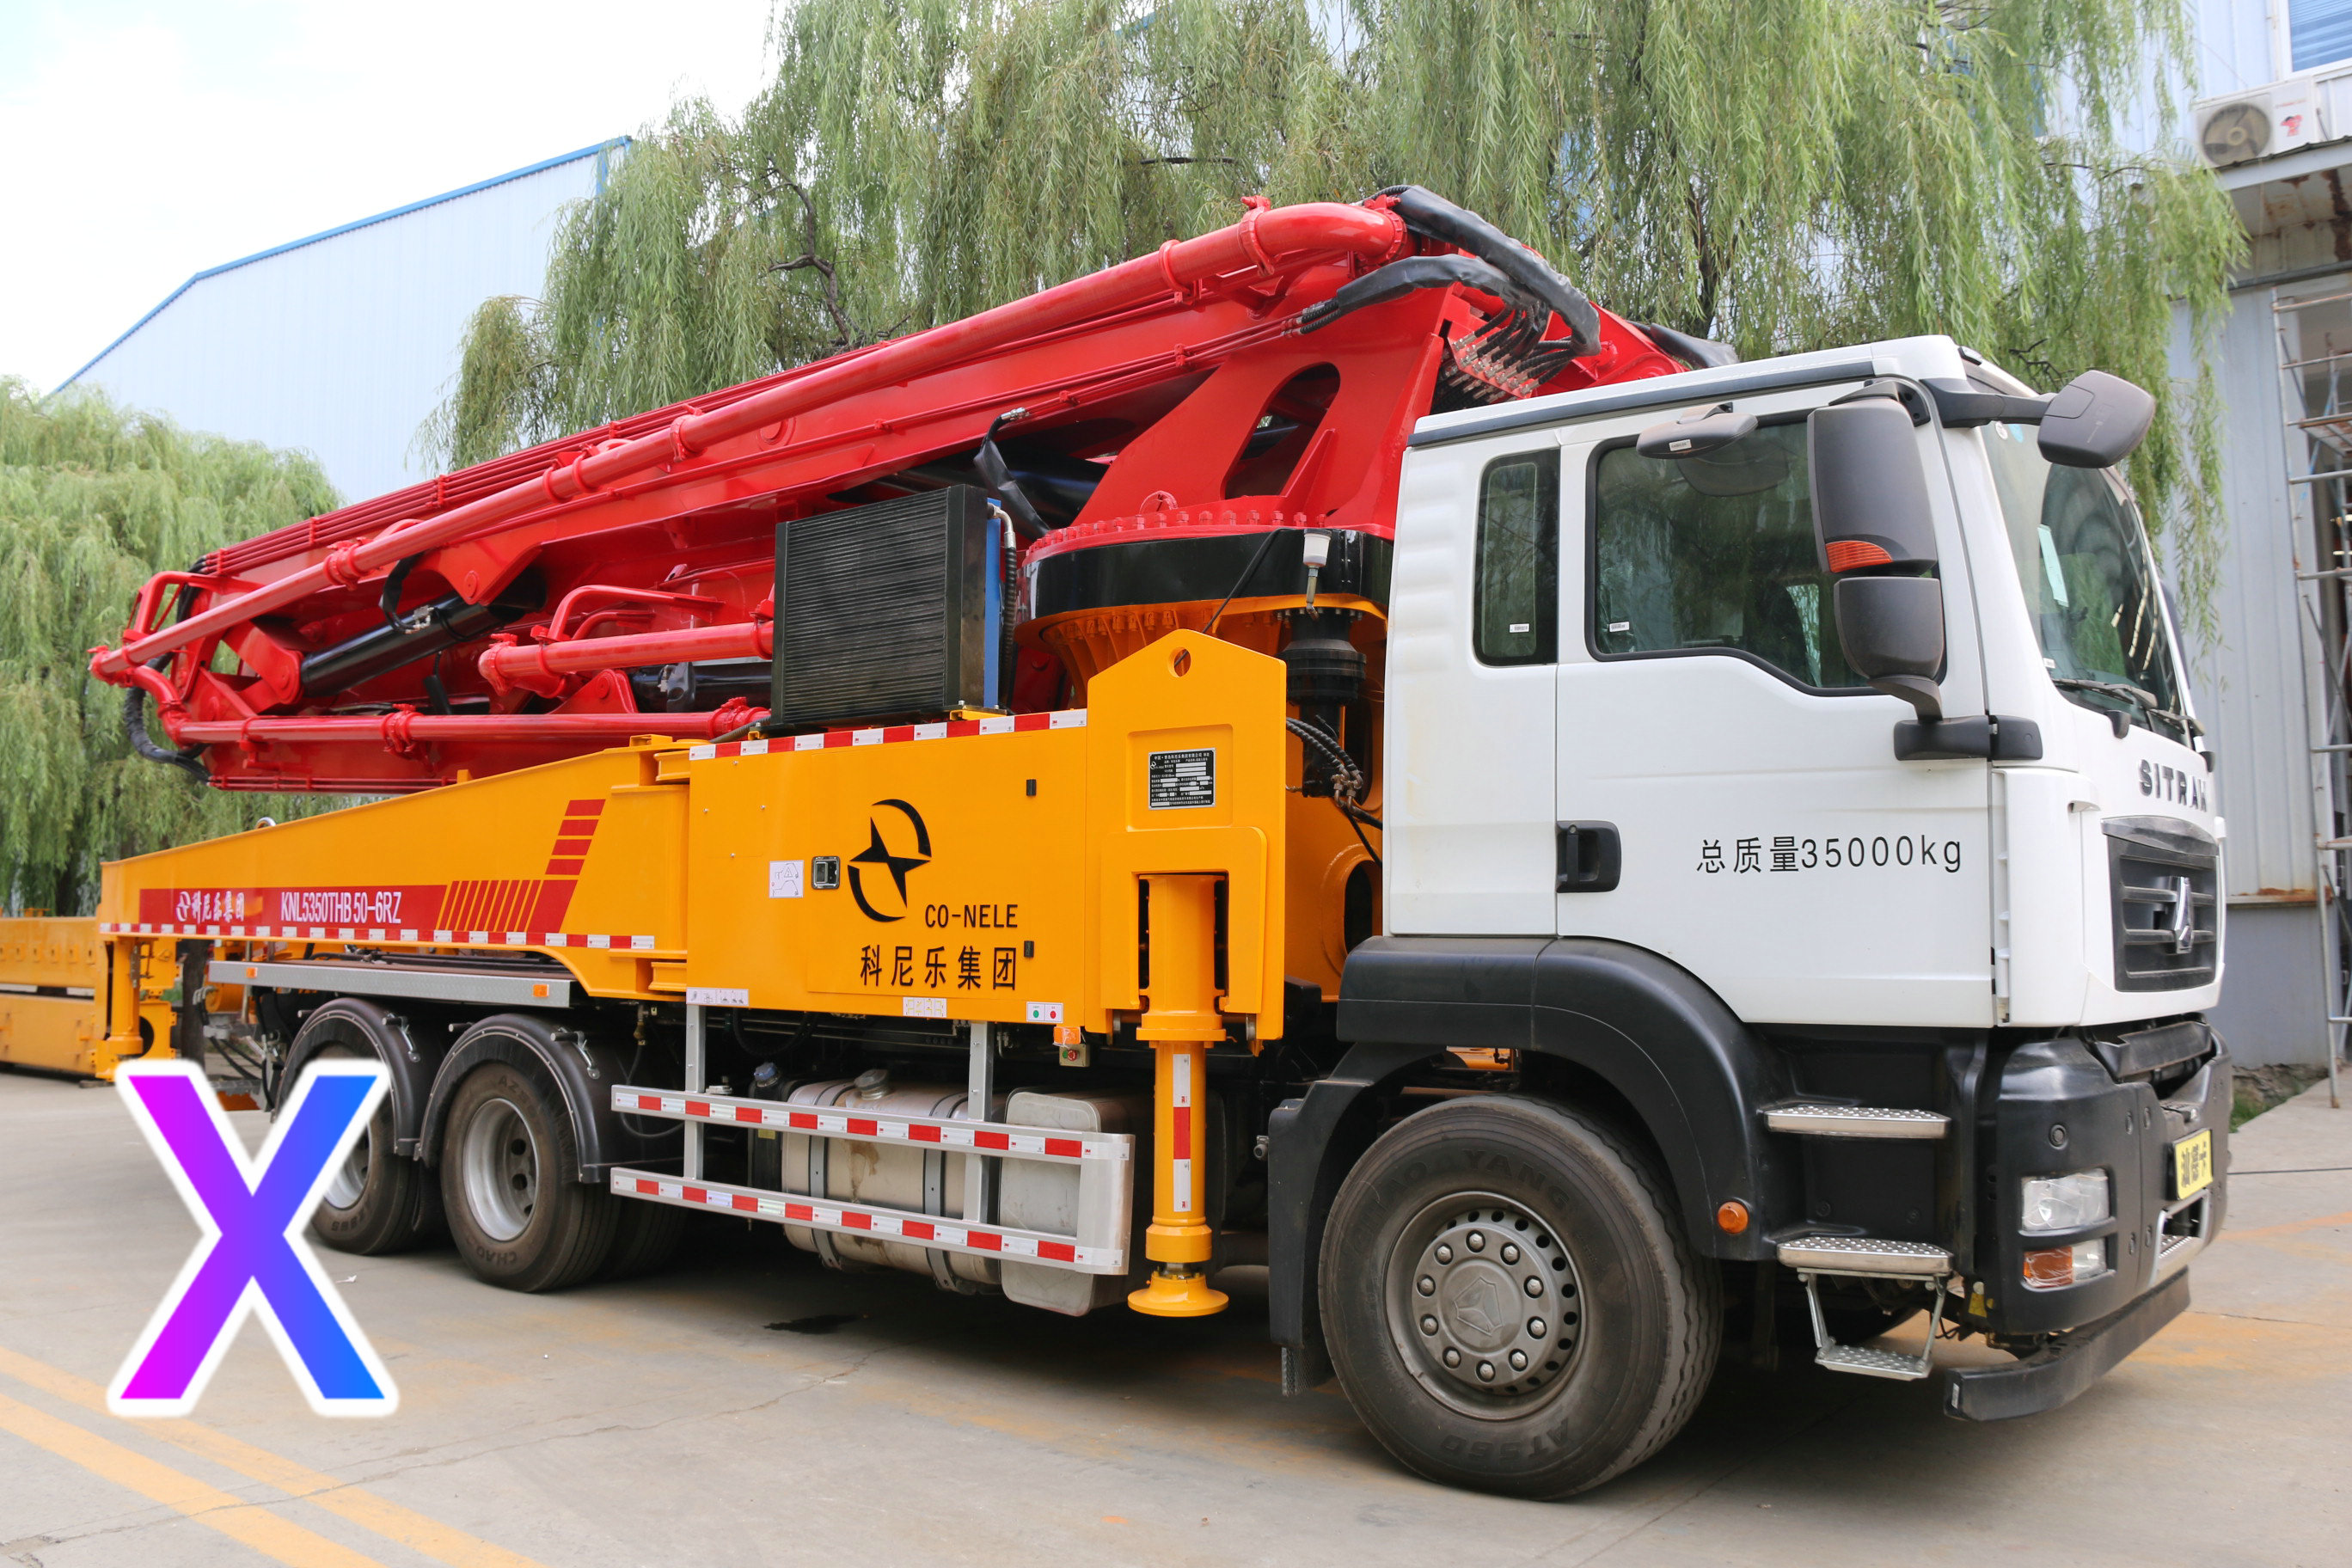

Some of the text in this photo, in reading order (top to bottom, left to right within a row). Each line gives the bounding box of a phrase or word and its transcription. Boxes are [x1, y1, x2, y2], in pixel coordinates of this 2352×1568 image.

[1696, 834, 1961, 874] 总质量35000kg
[925, 903, 1019, 928] CO-NELE
[861, 945, 1017, 991] 科尼乐集团
[1463, 1148, 1570, 1209] YANG
